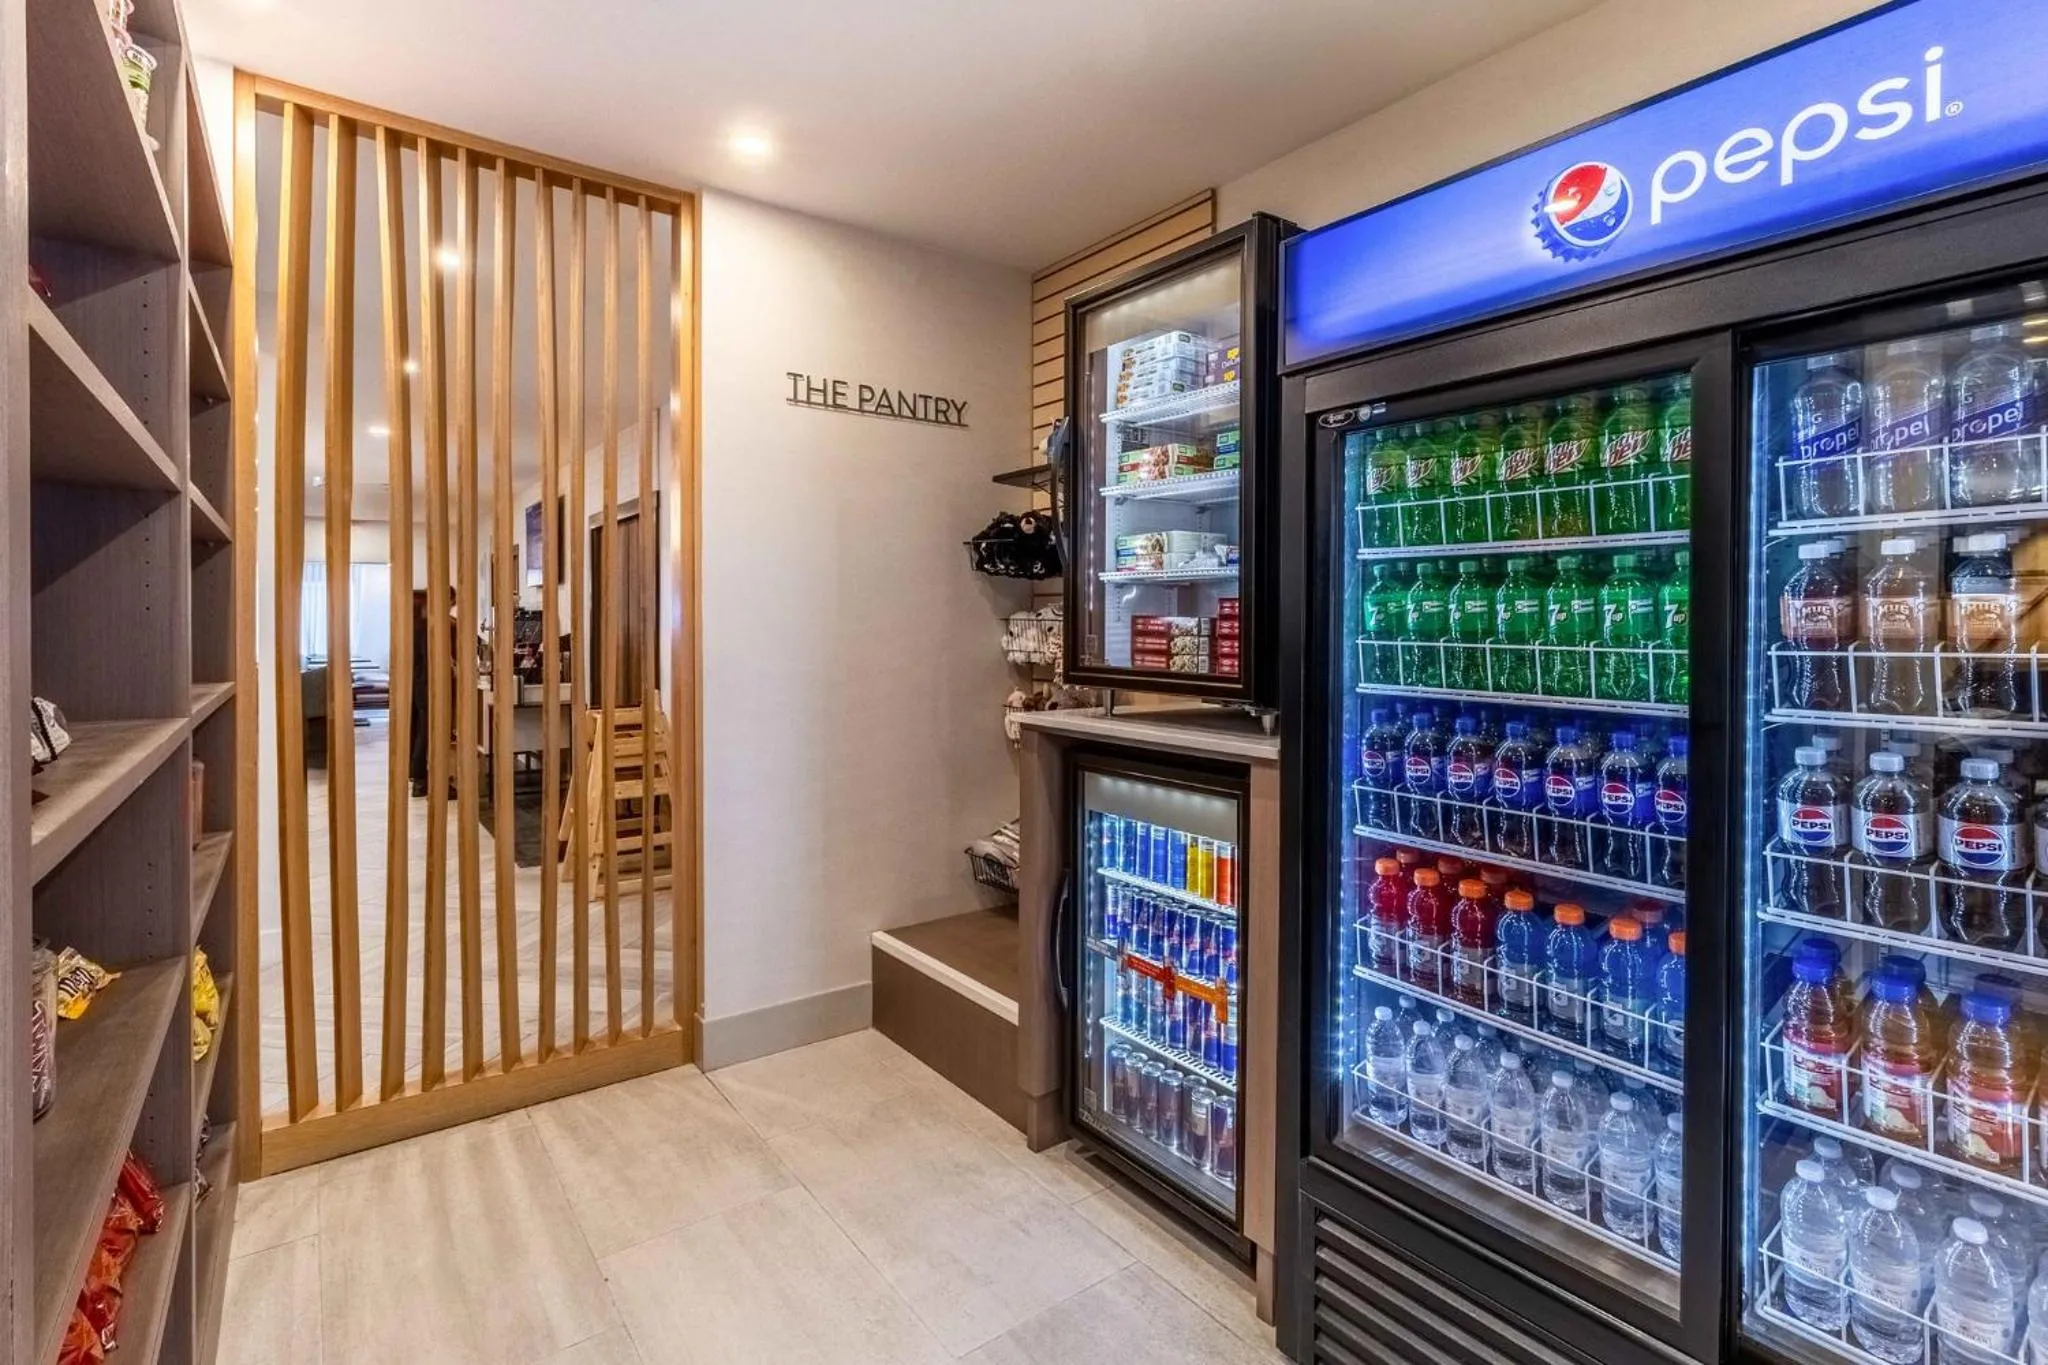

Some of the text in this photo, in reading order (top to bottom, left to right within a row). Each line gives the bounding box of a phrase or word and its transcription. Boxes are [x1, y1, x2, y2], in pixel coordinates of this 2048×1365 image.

[1649, 46, 1944, 225] pepsi
[786, 372, 968, 424] THE PANTRY
[1801, 420, 1859, 460] propel
[1952, 401, 2024, 443] propel
[1793, 820, 1832, 831] PEPSI
[1866, 827, 1909, 841] PEPSI
[1955, 839, 2002, 852] PEPSI
